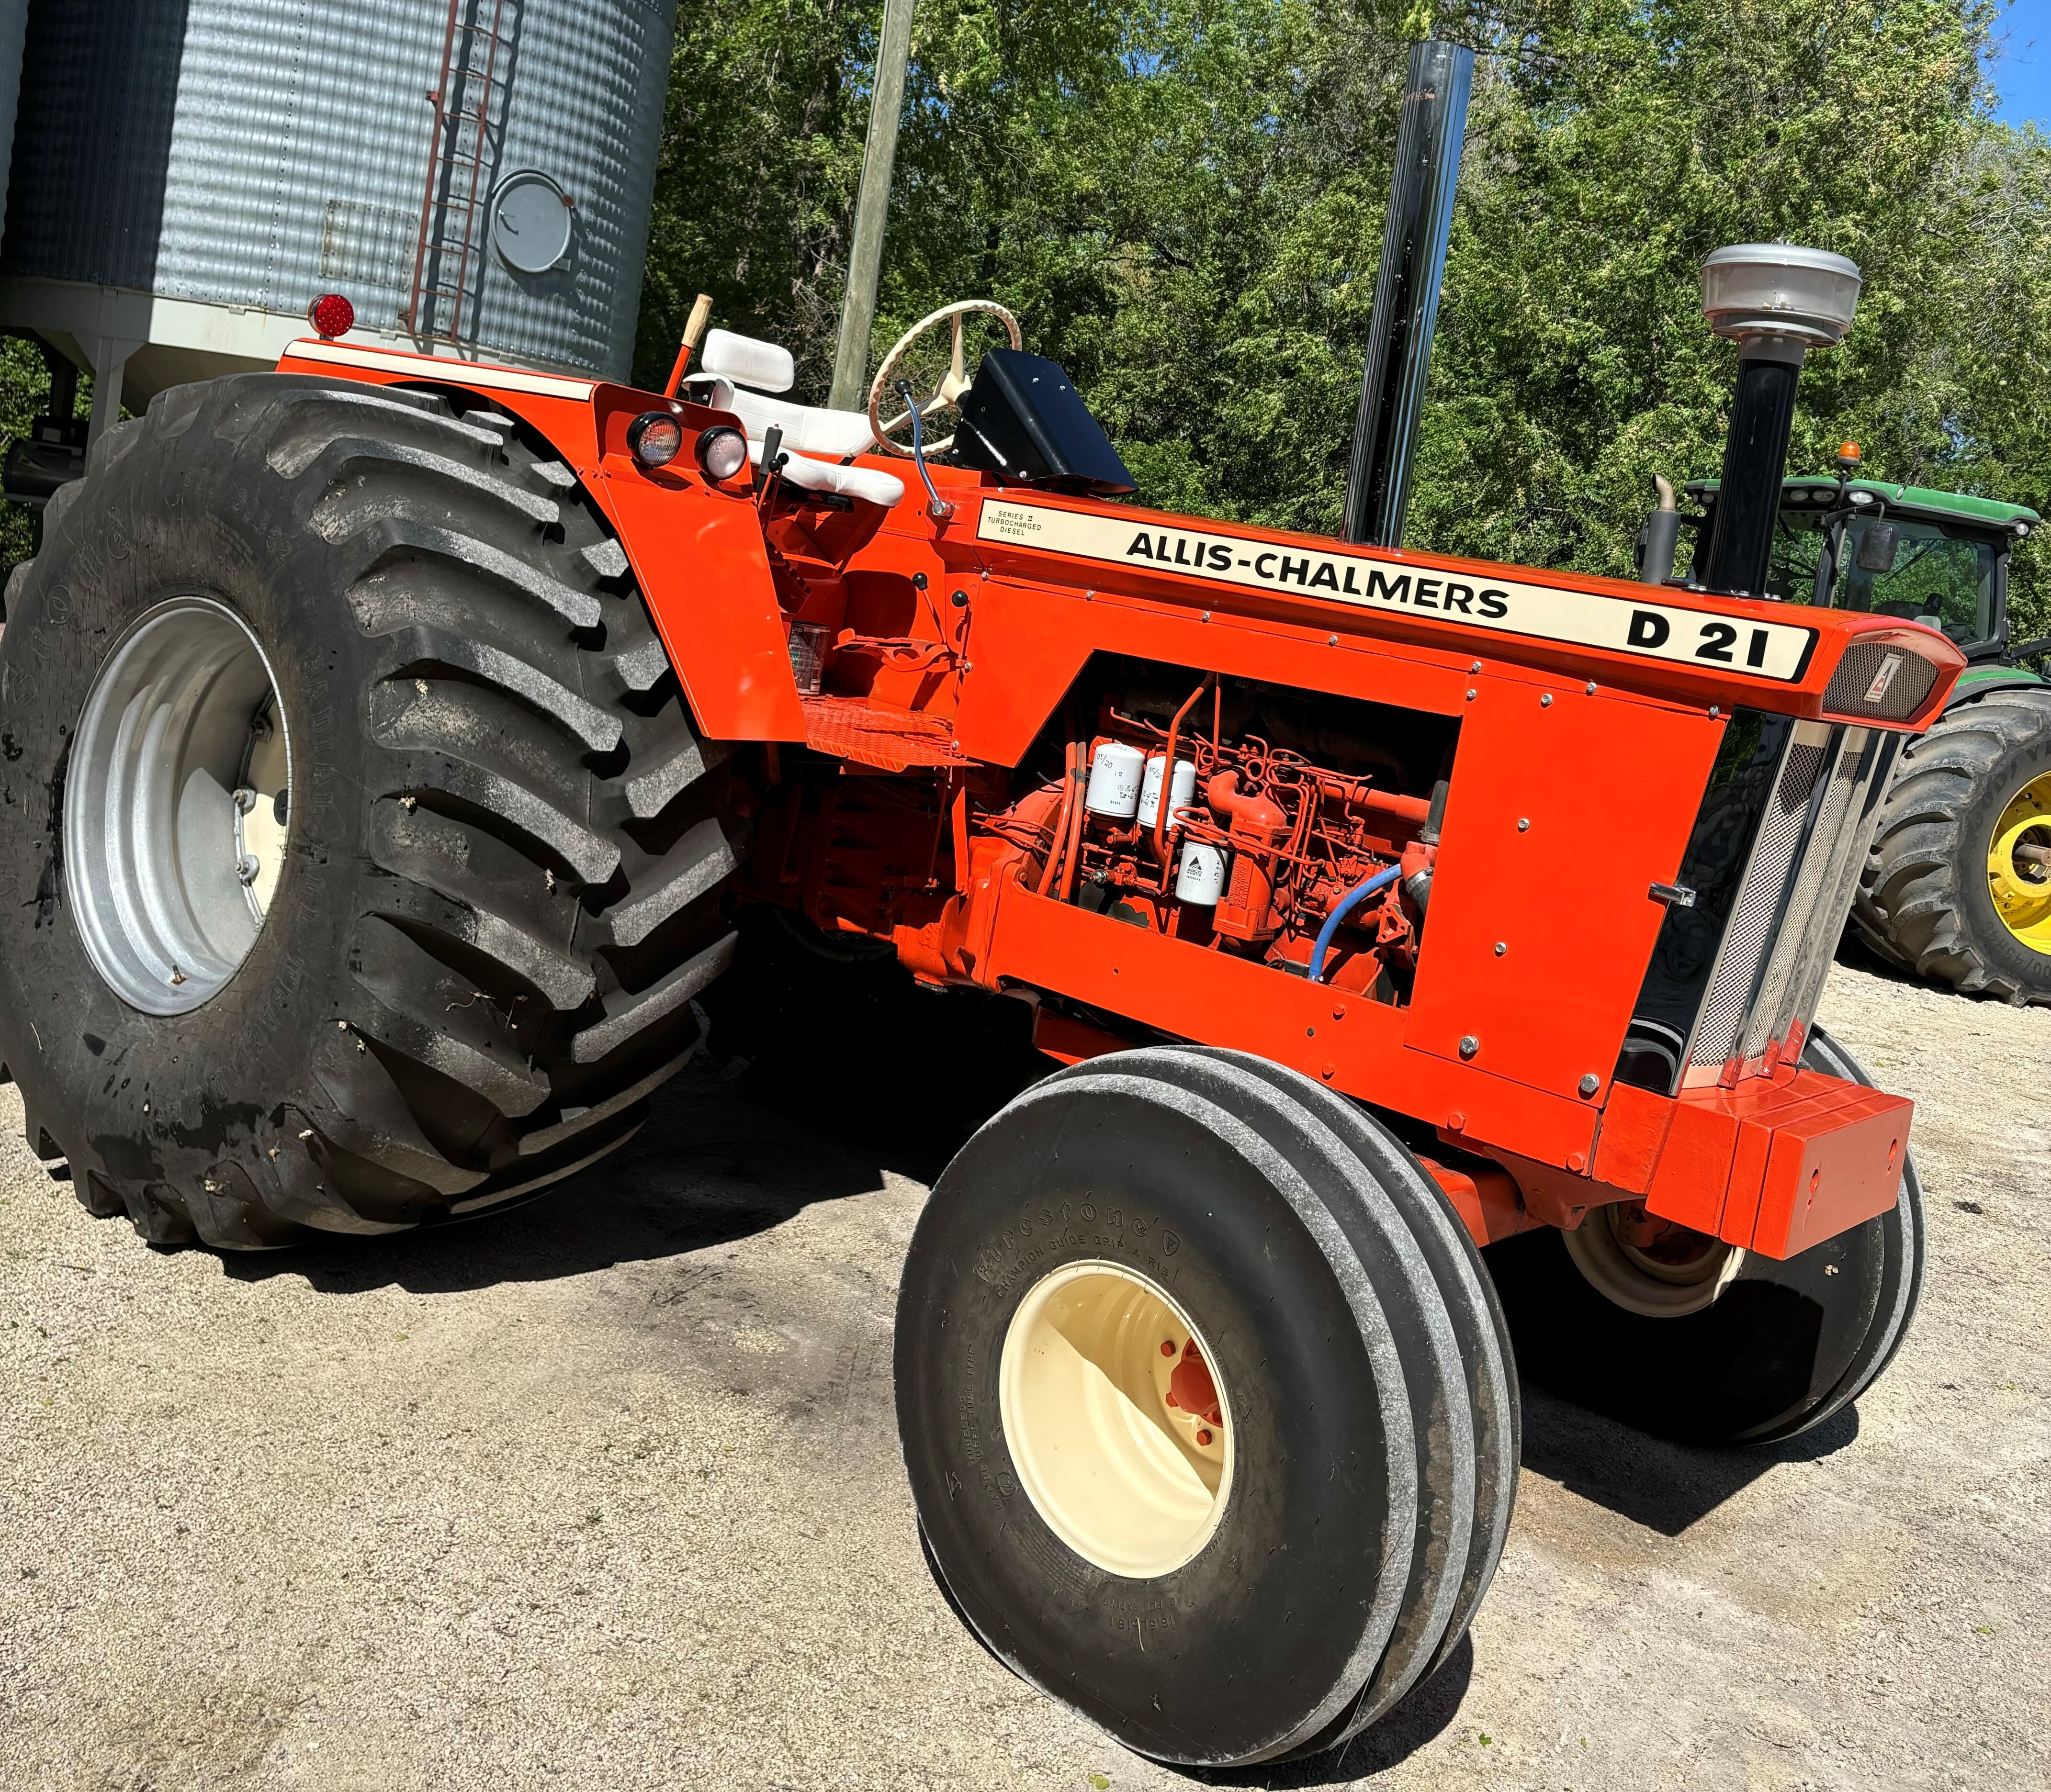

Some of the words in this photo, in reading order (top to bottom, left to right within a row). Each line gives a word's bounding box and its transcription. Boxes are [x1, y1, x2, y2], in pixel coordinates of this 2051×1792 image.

[988, 516, 1041, 531] TURBOCHARGED
[998, 511, 1023, 520] SERIES
[1000, 526, 1025, 536] DIESEL
[1126, 532, 1510, 618] ALLIS-CHALMERS
[1626, 609, 1670, 649] D
[1695, 622, 1769, 668] 21
[299, 646, 335, 815] RADIAL
[1097, 753, 1113, 769] 05/20
[297, 843, 329, 926] ALL
[972, 1201, 1148, 1285] Firestone
[996, 1246, 1045, 1299] CHAMPION
[1049, 1234, 1087, 1250] GUIDE
[1093, 1235, 1124, 1250] GRIP
[1148, 1255, 1170, 1277] RIB
[966, 1343, 976, 1378] TYPE
[966, 1384, 975, 1415] TUBE
[958, 1395, 976, 1465] TUBELESS
[969, 1423, 983, 1460] USED
[980, 1463, 991, 1482] BE
[985, 1485, 1003, 1511] MAY
[1207, 1531, 1224, 1554] SPEED
[1102, 1596, 1138, 1612] RATING
[1145, 1599, 1163, 1611] PLY
